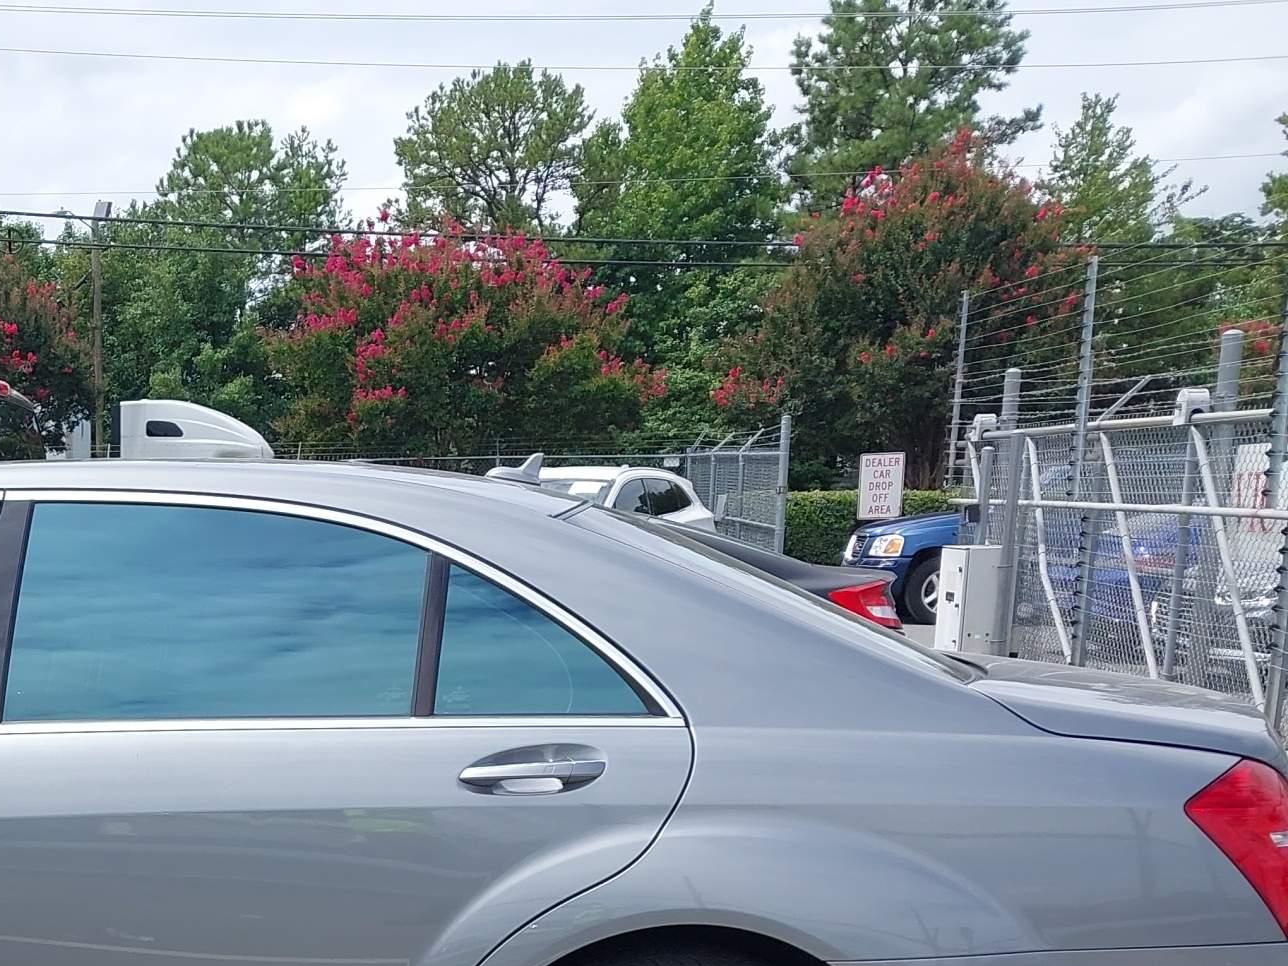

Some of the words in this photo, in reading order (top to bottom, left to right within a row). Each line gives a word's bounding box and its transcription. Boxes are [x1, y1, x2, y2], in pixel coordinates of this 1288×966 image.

[865, 457, 901, 467] DEALER
[873, 469, 891, 479] CAR
[868, 481, 894, 491] DROP
[871, 493, 890, 503] OFF
[867, 504, 892, 515] AREA
